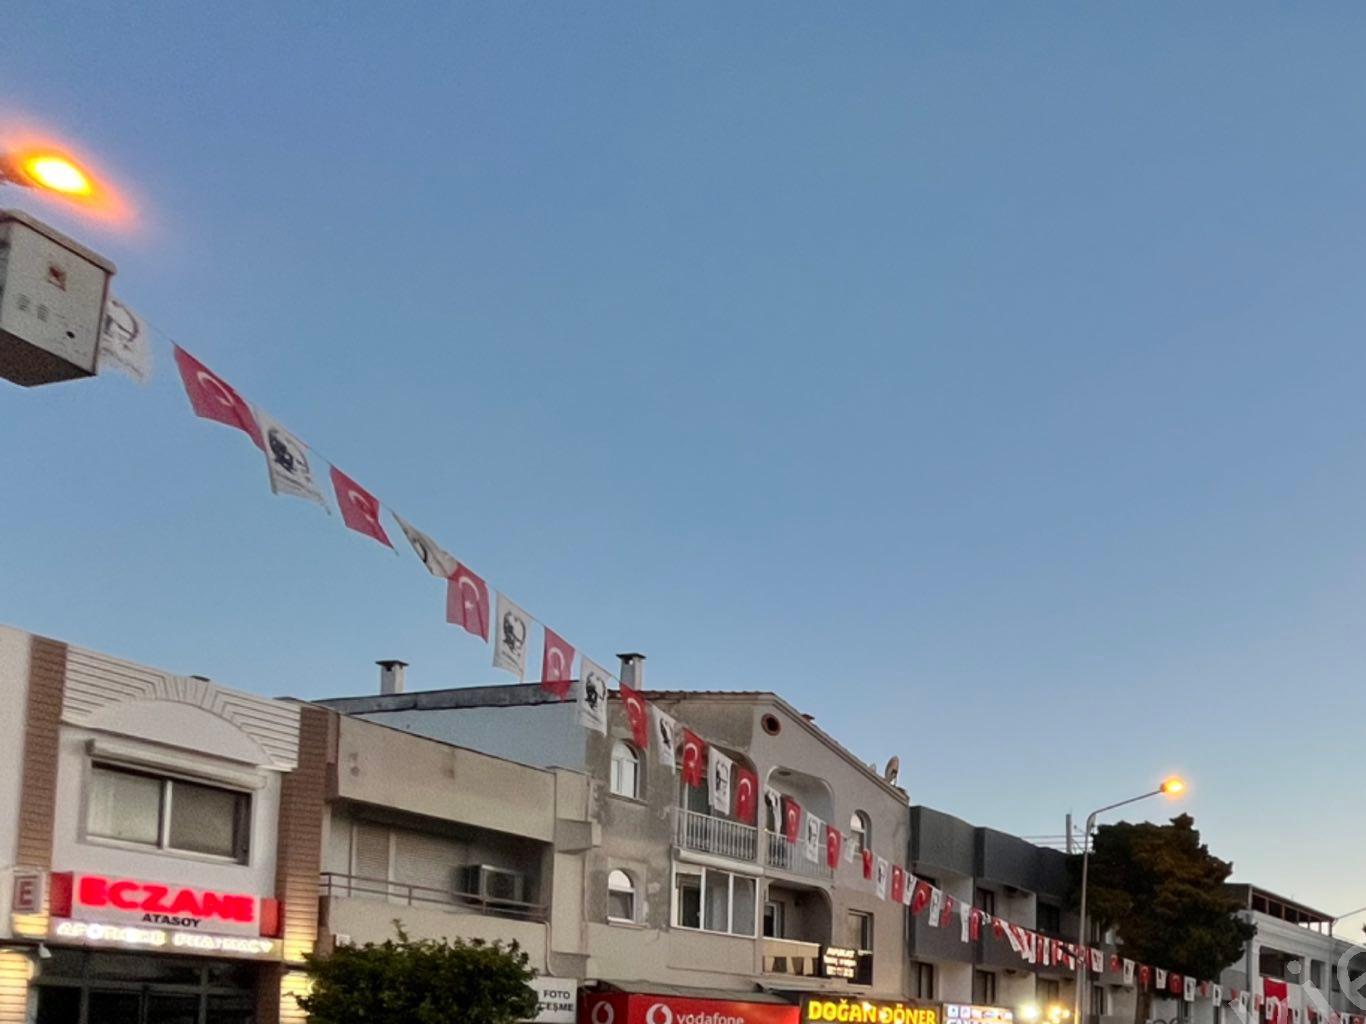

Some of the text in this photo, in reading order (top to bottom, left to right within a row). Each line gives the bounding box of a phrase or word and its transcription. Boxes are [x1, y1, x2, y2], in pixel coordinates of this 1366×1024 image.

[79, 876, 255, 923] ECZANE
[142, 913, 202, 928] ATASOY
[543, 990, 571, 999] FOTO
[808, 999, 877, 1023] DOĞAN
